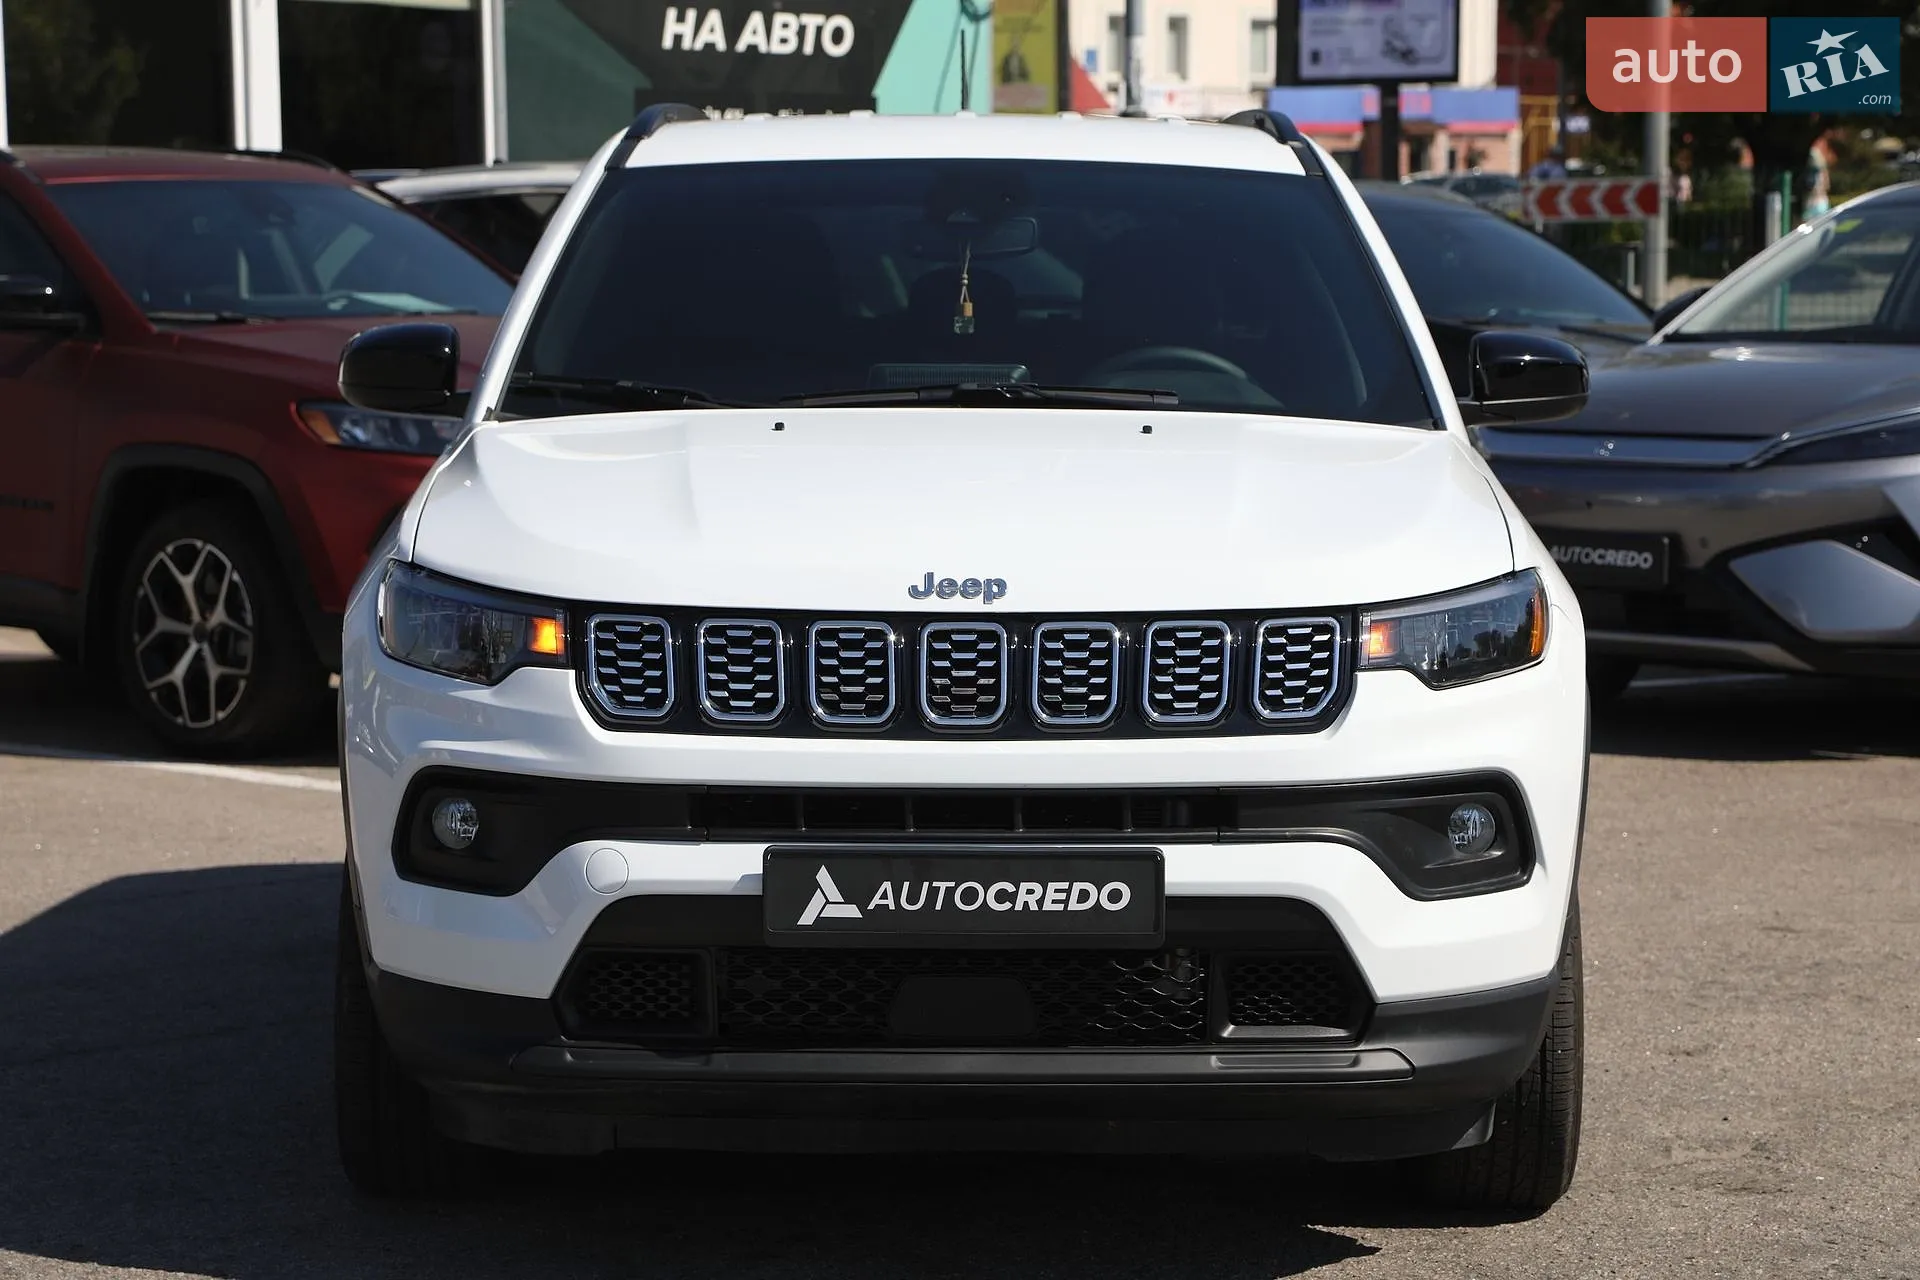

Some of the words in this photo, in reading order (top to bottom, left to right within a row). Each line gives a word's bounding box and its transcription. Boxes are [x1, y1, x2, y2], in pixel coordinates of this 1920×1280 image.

[661, 6, 727, 52] НА
[735, 10, 855, 57] АВТО
[908, 571, 1007, 604] Jeep
[866, 880, 1131, 911] AUTOCREDO
